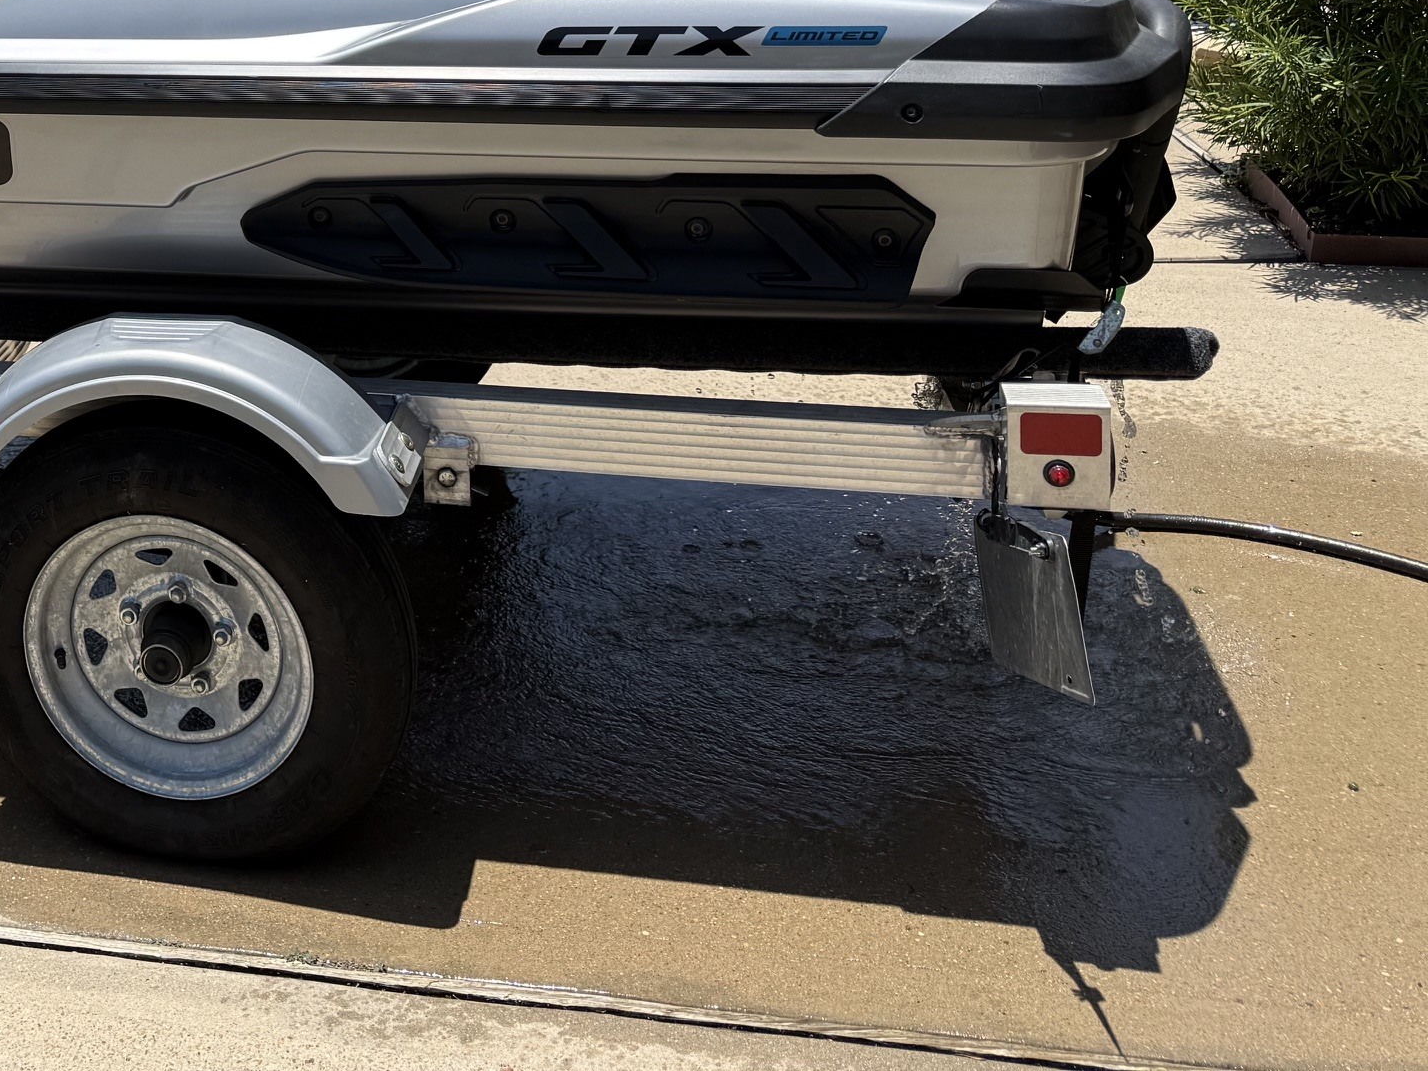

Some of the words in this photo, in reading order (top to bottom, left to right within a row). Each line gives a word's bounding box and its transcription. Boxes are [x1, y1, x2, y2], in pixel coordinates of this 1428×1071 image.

[536, 25, 766, 57] GTX
[769, 29, 880, 42] LIMITED
[77, 468, 204, 498] TRAIL
